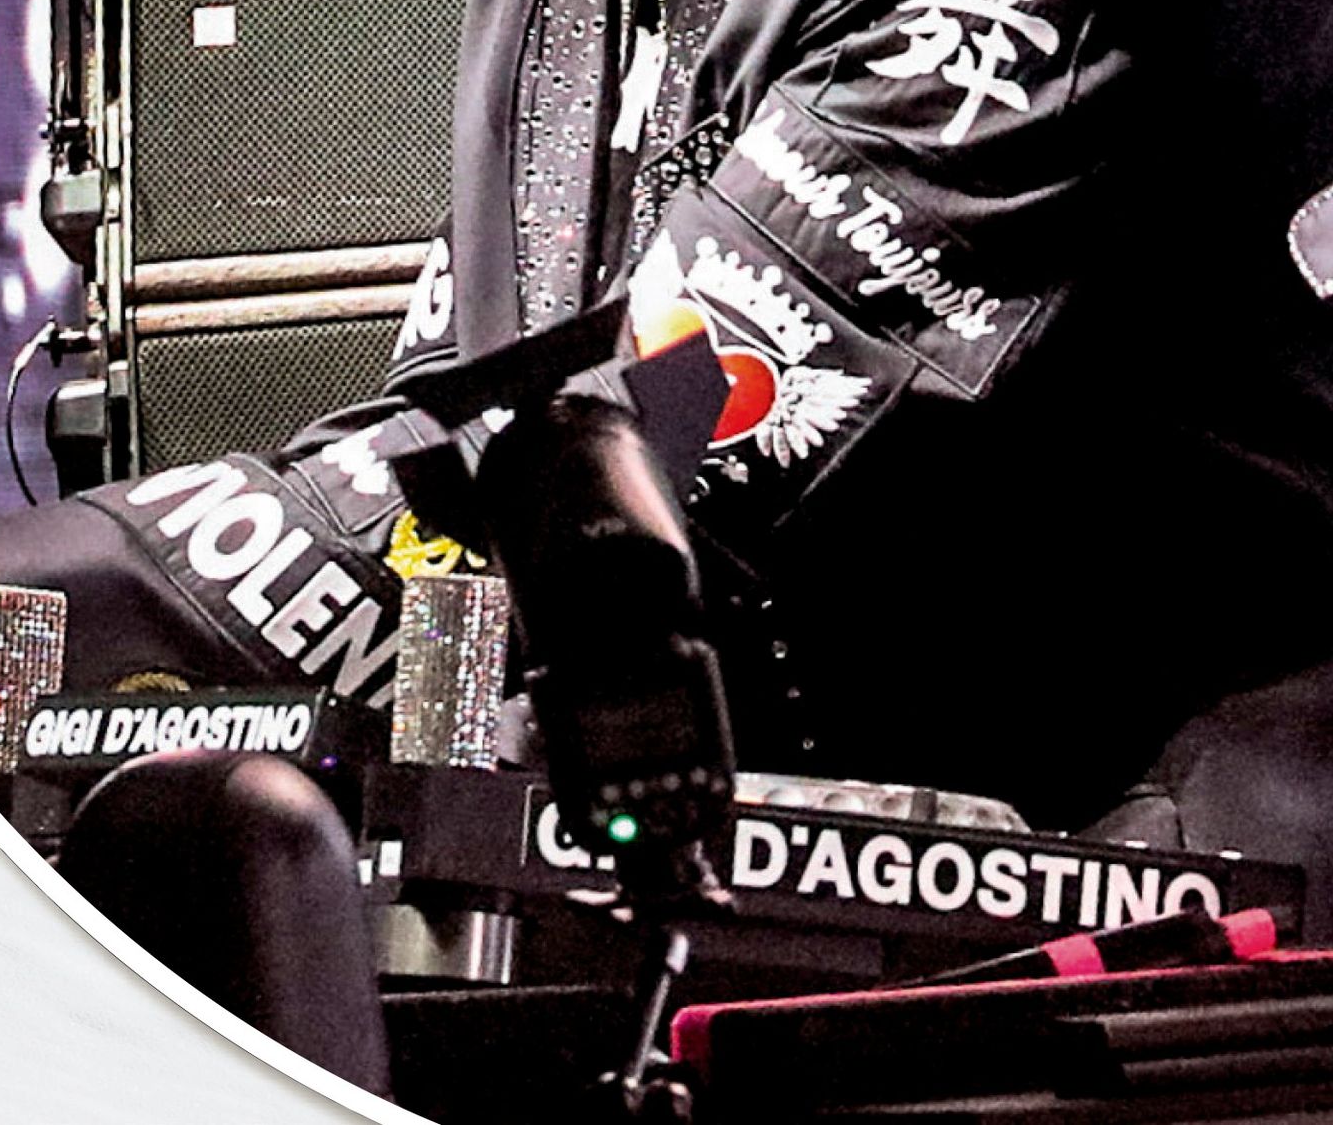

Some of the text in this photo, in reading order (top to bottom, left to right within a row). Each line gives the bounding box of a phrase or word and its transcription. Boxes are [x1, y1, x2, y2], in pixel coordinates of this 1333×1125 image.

[836, 184, 1001, 341] Toujours
[25, 703, 312, 758] GIGI D'AGOSTINO
[731, 818, 1221, 929] D'AGOSTINO
